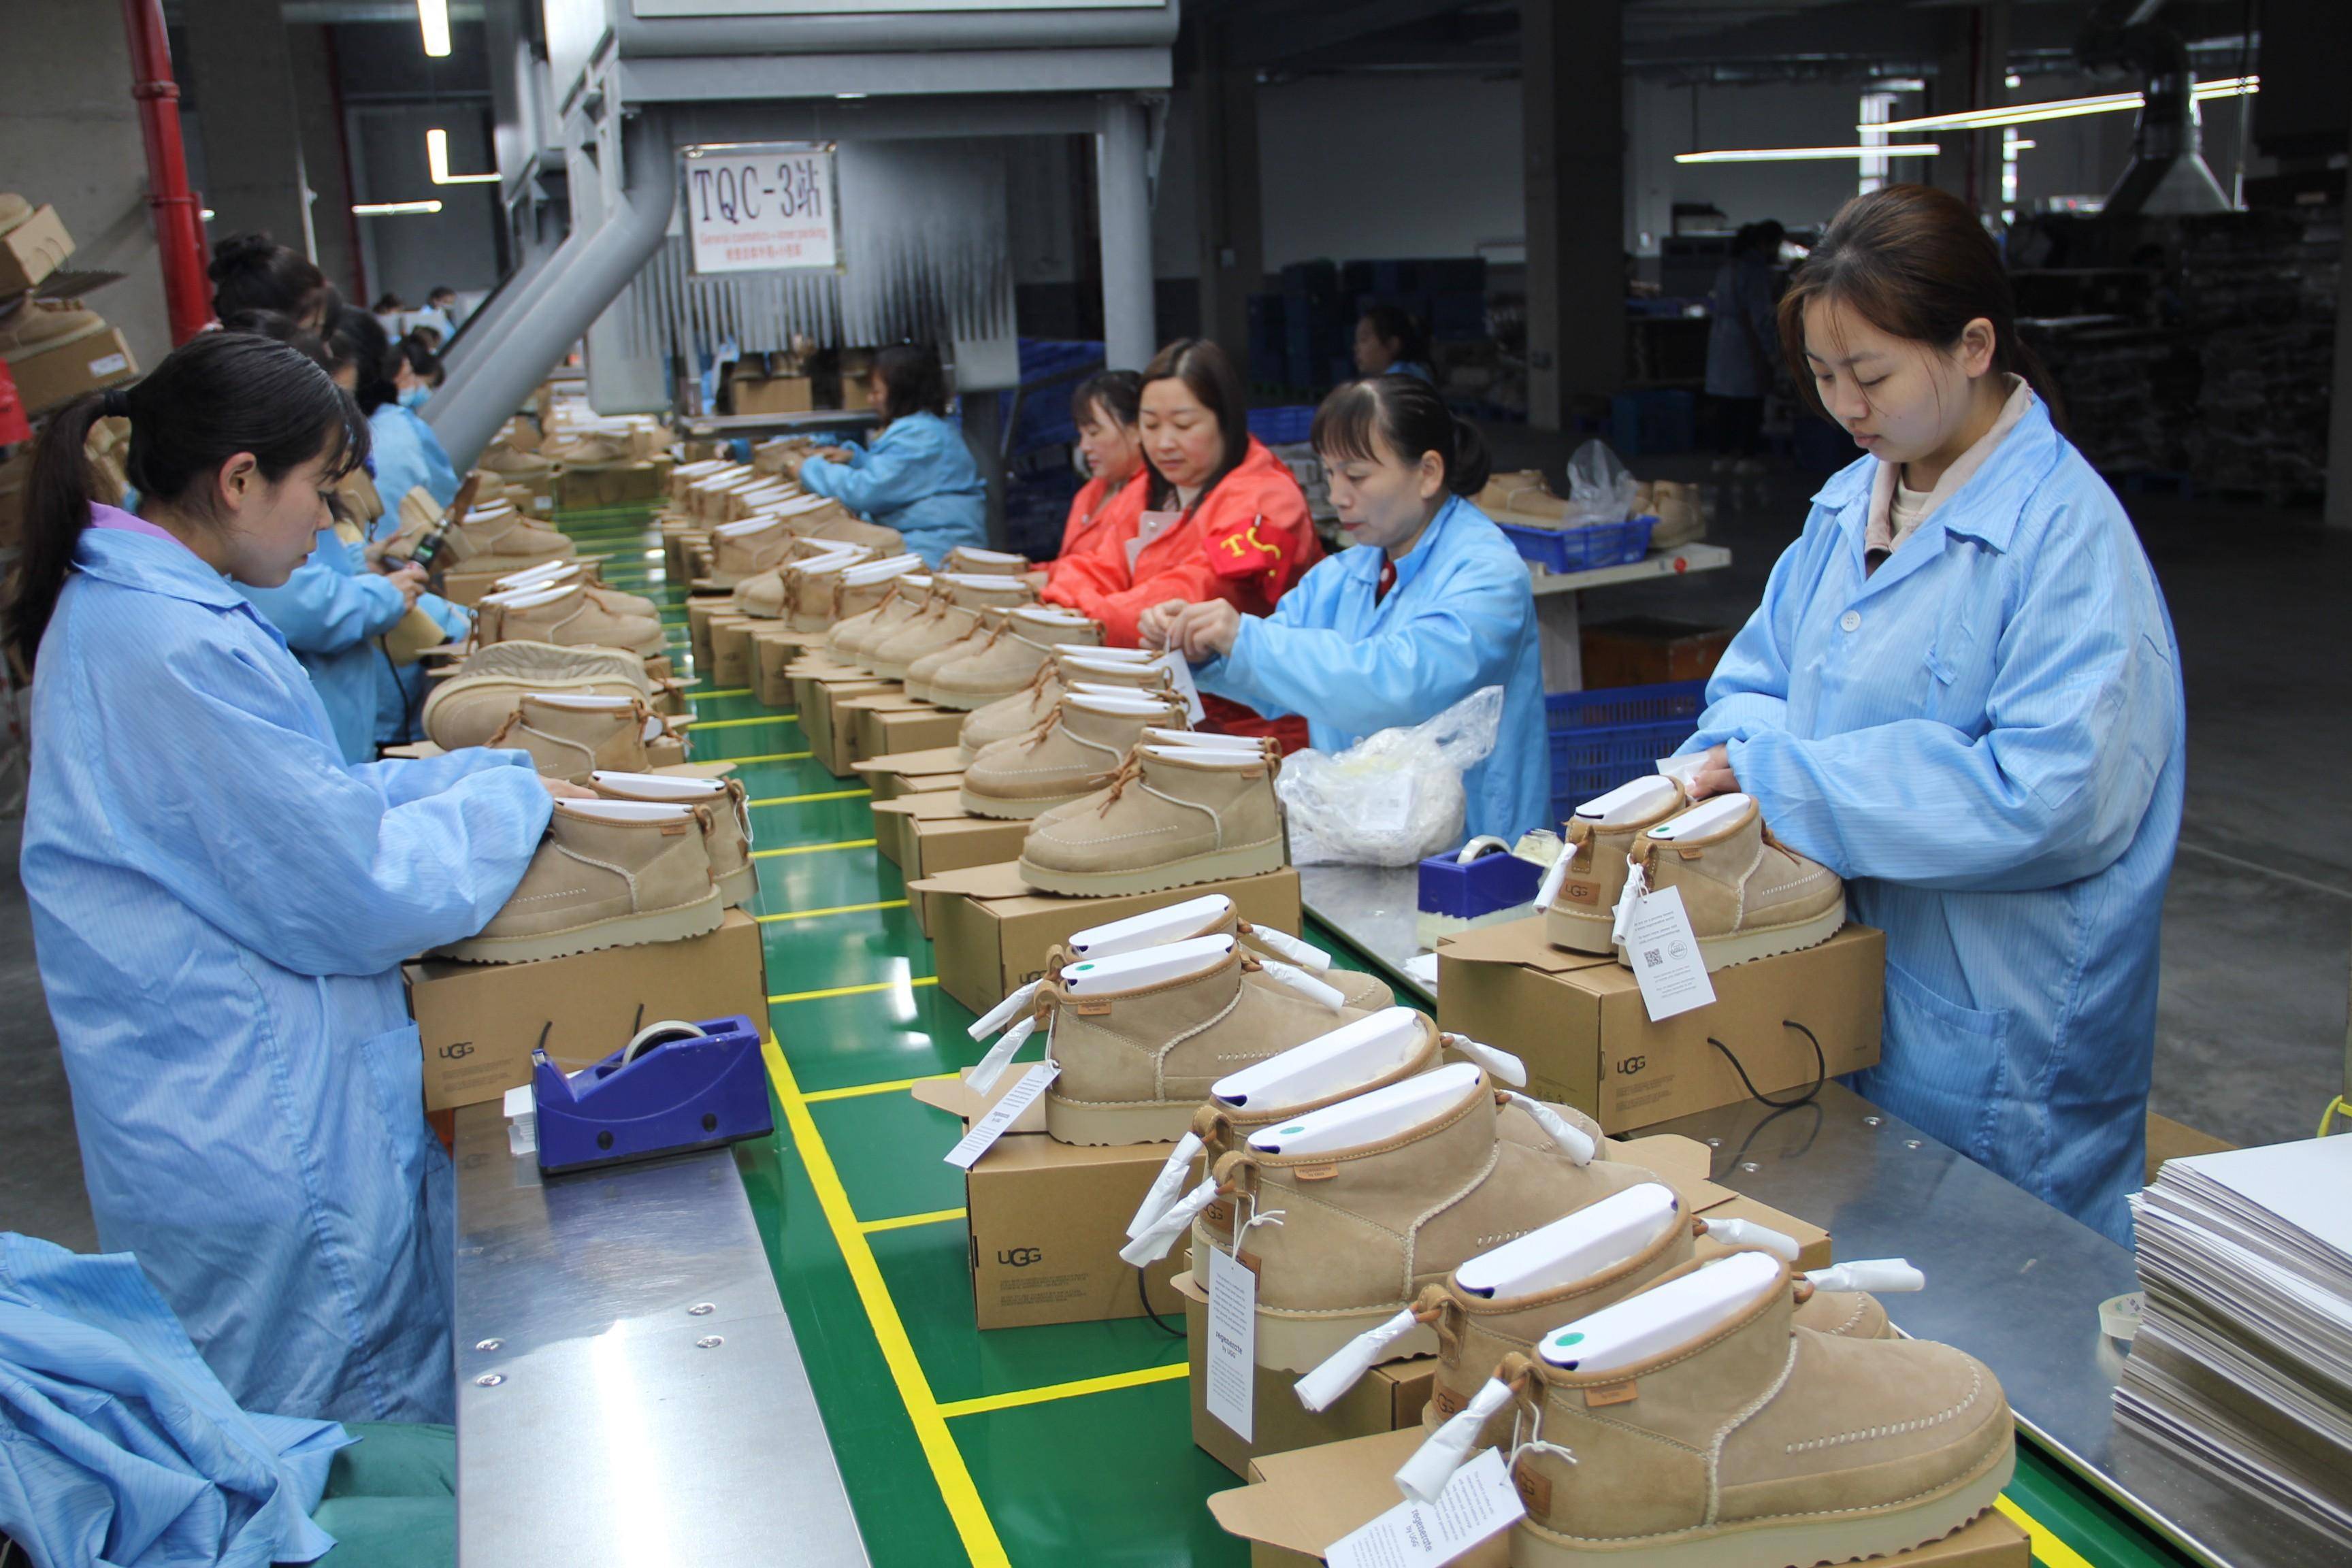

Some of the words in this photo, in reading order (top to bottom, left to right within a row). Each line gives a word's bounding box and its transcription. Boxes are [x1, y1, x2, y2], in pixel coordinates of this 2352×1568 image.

[1566, 884, 1588, 897] UGG
[440, 1042, 474, 1059] UGG
[1617, 1056, 1646, 1075] UGG
[997, 1247, 1042, 1267] UGG
[1215, 1331, 1243, 1355] regenerate
[1411, 1508, 1433, 1552] regenerate
